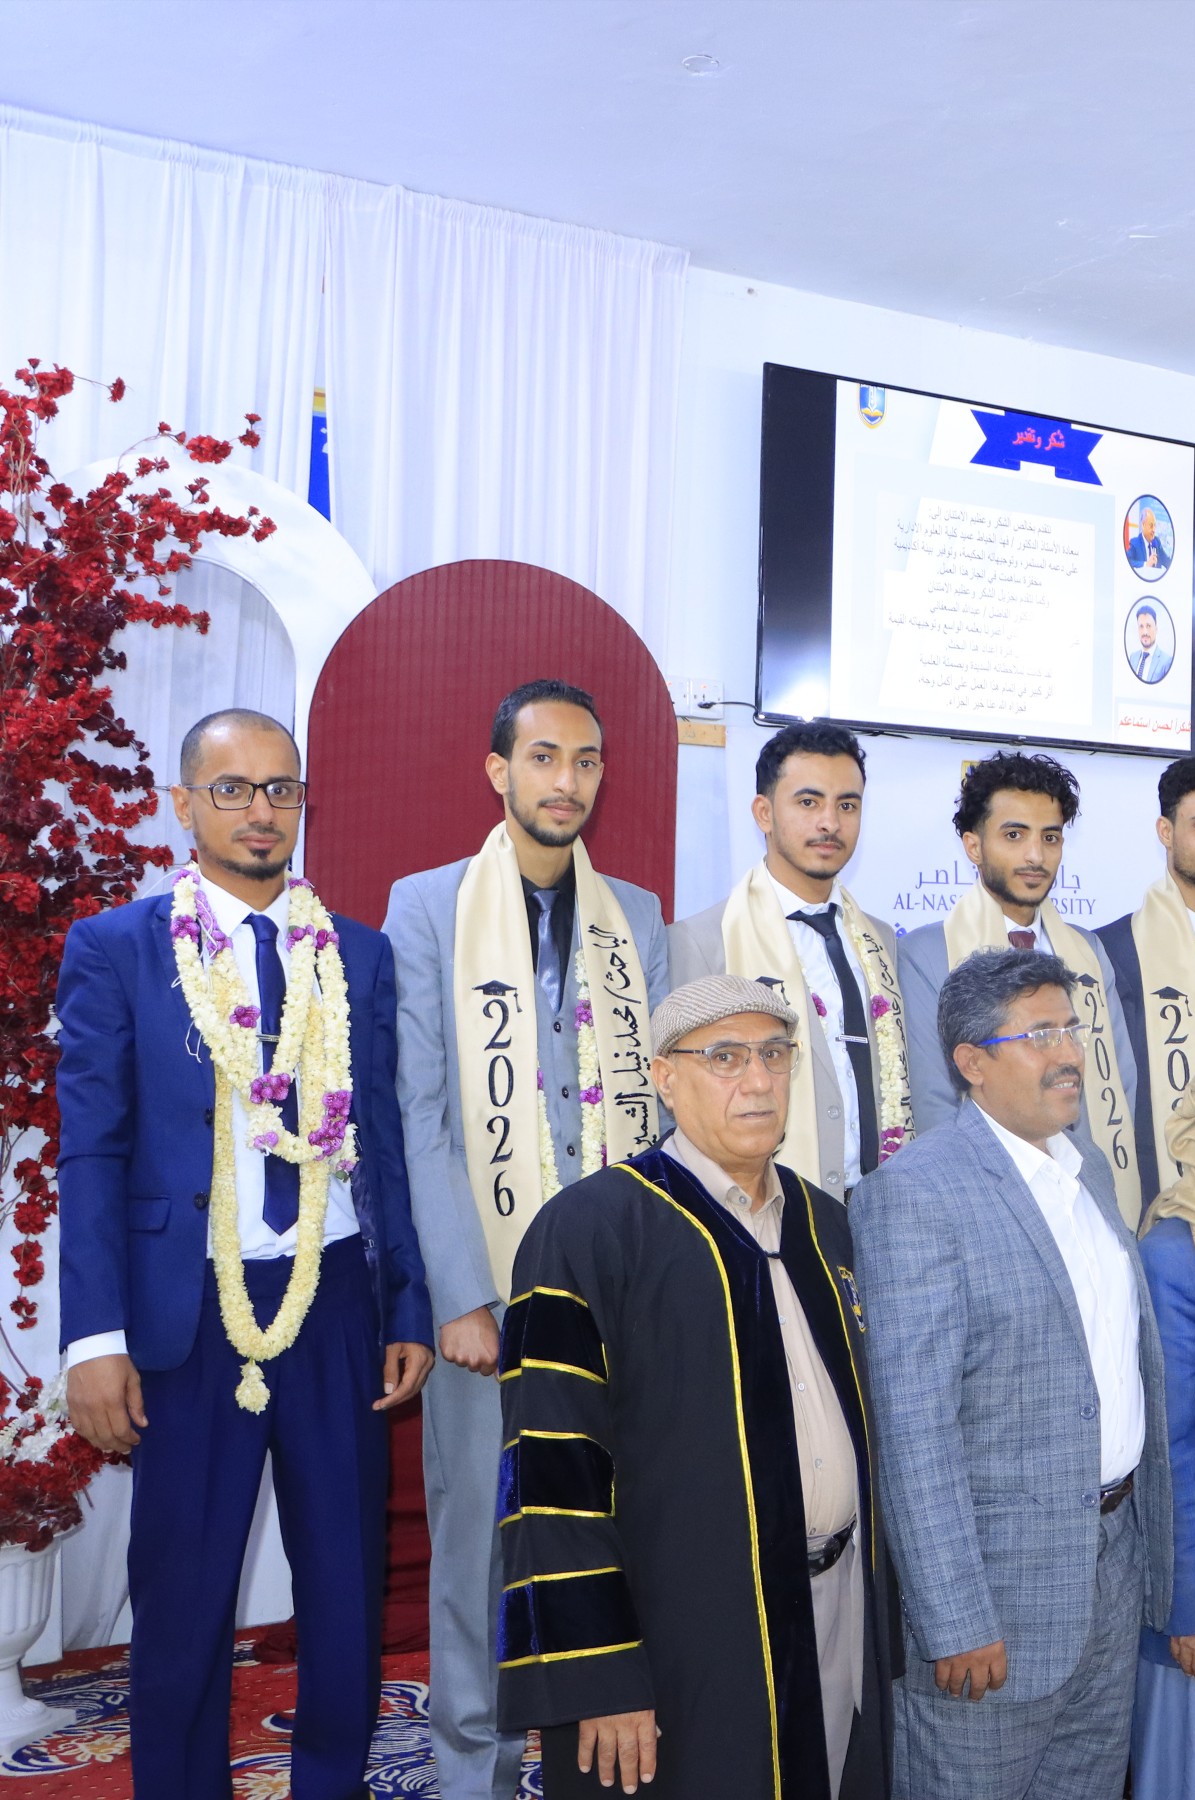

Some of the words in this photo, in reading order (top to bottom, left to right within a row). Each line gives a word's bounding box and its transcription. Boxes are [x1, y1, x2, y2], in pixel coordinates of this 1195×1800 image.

[1012, 427, 1042, 449] وتقدير
[1045, 429, 1065, 451] شكر
[994, 516, 1010, 529] الشكر
[893, 892, 963, 911] AL-NAS
[1084, 991, 1129, 1170] 2026
[482, 999, 516, 1217] 2026
